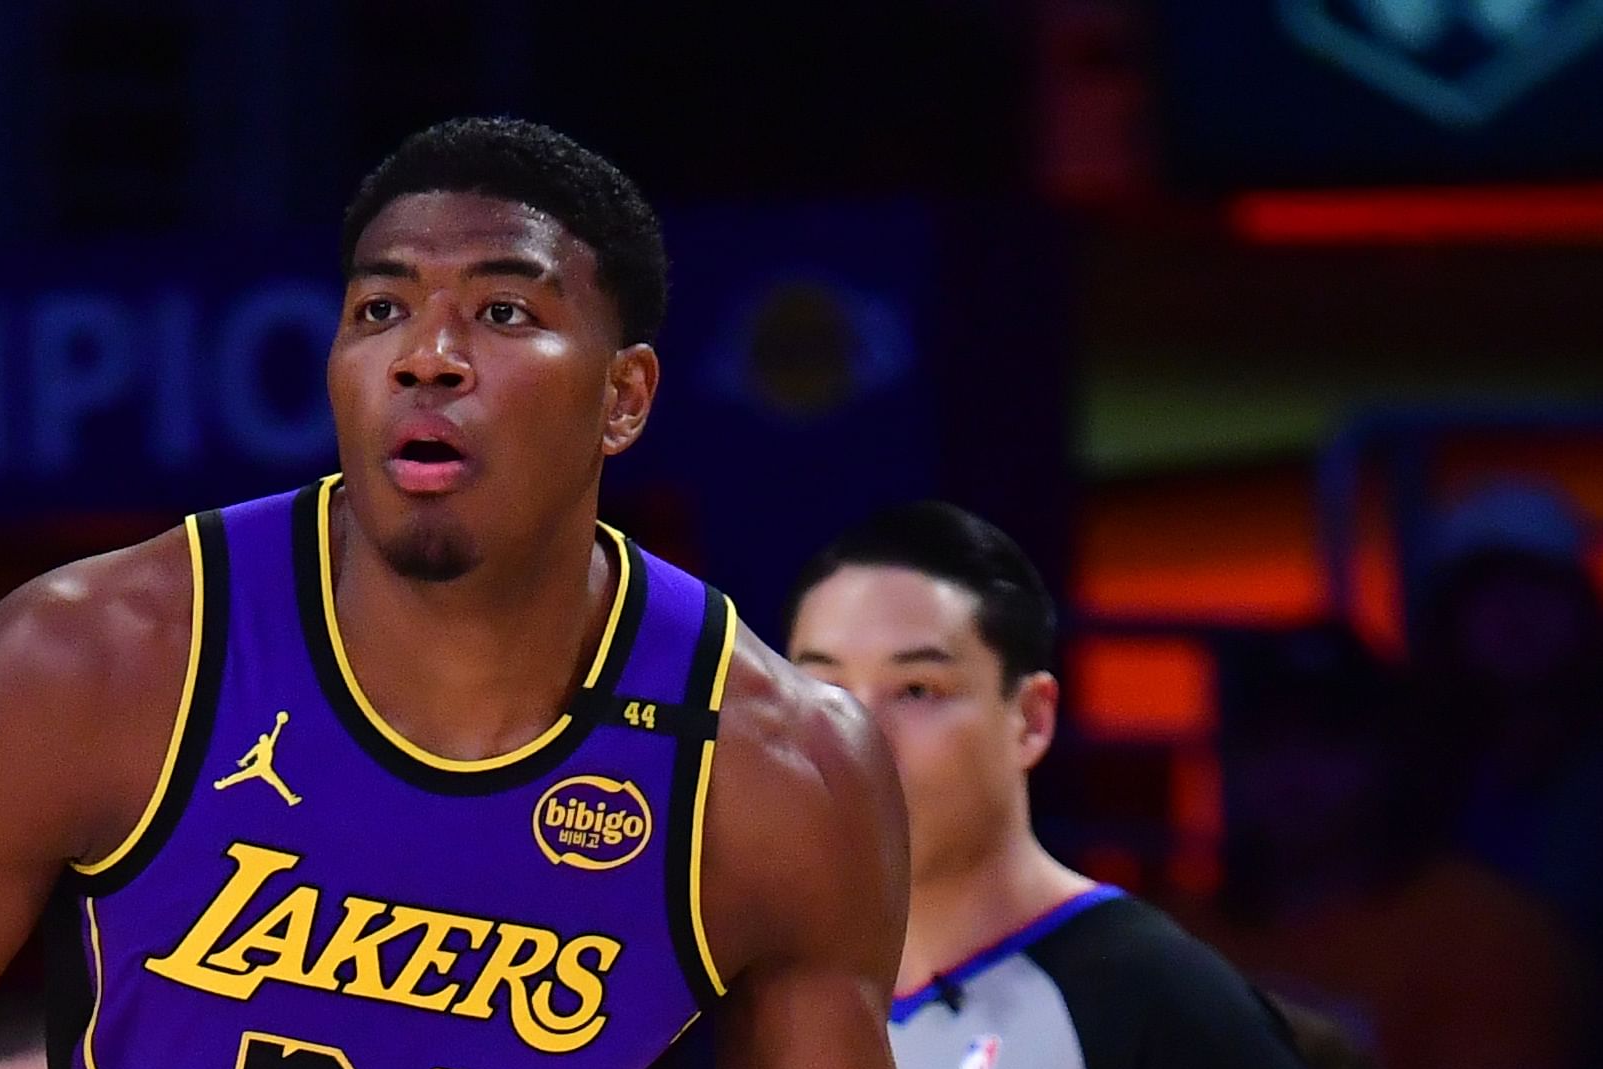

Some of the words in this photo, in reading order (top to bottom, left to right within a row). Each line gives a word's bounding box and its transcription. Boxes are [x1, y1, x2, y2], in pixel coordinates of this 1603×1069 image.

[623, 701, 657, 730] 44
[545, 797, 644, 845] bibigo
[558, 829, 601, 849] 비비고
[143, 841, 622, 1054] LAKERS
